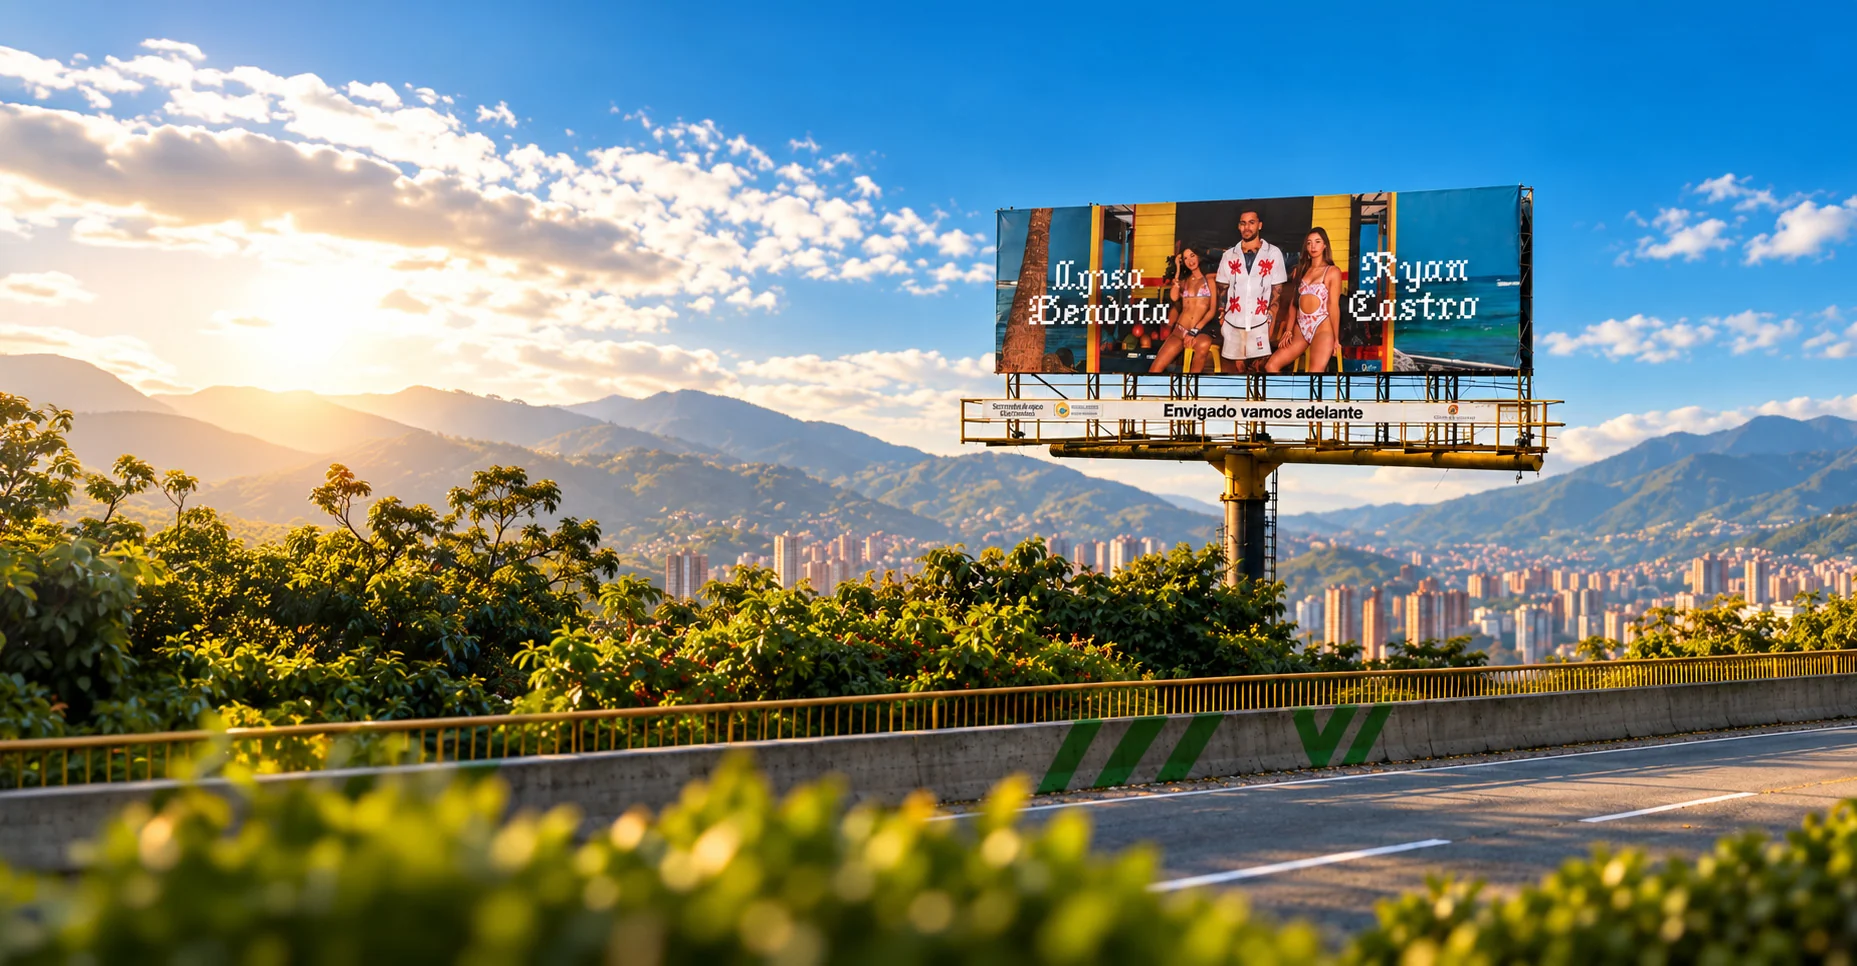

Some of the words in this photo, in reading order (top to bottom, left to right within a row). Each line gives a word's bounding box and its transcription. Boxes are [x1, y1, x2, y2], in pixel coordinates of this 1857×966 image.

[1361, 251, 1468, 293] Ryan
[1028, 295, 1170, 325] Bendita
[1349, 289, 1479, 321] Castro
[1163, 403, 1237, 420] Envigado
[1241, 406, 1292, 419] vamos
[1296, 405, 1364, 419] adelante
